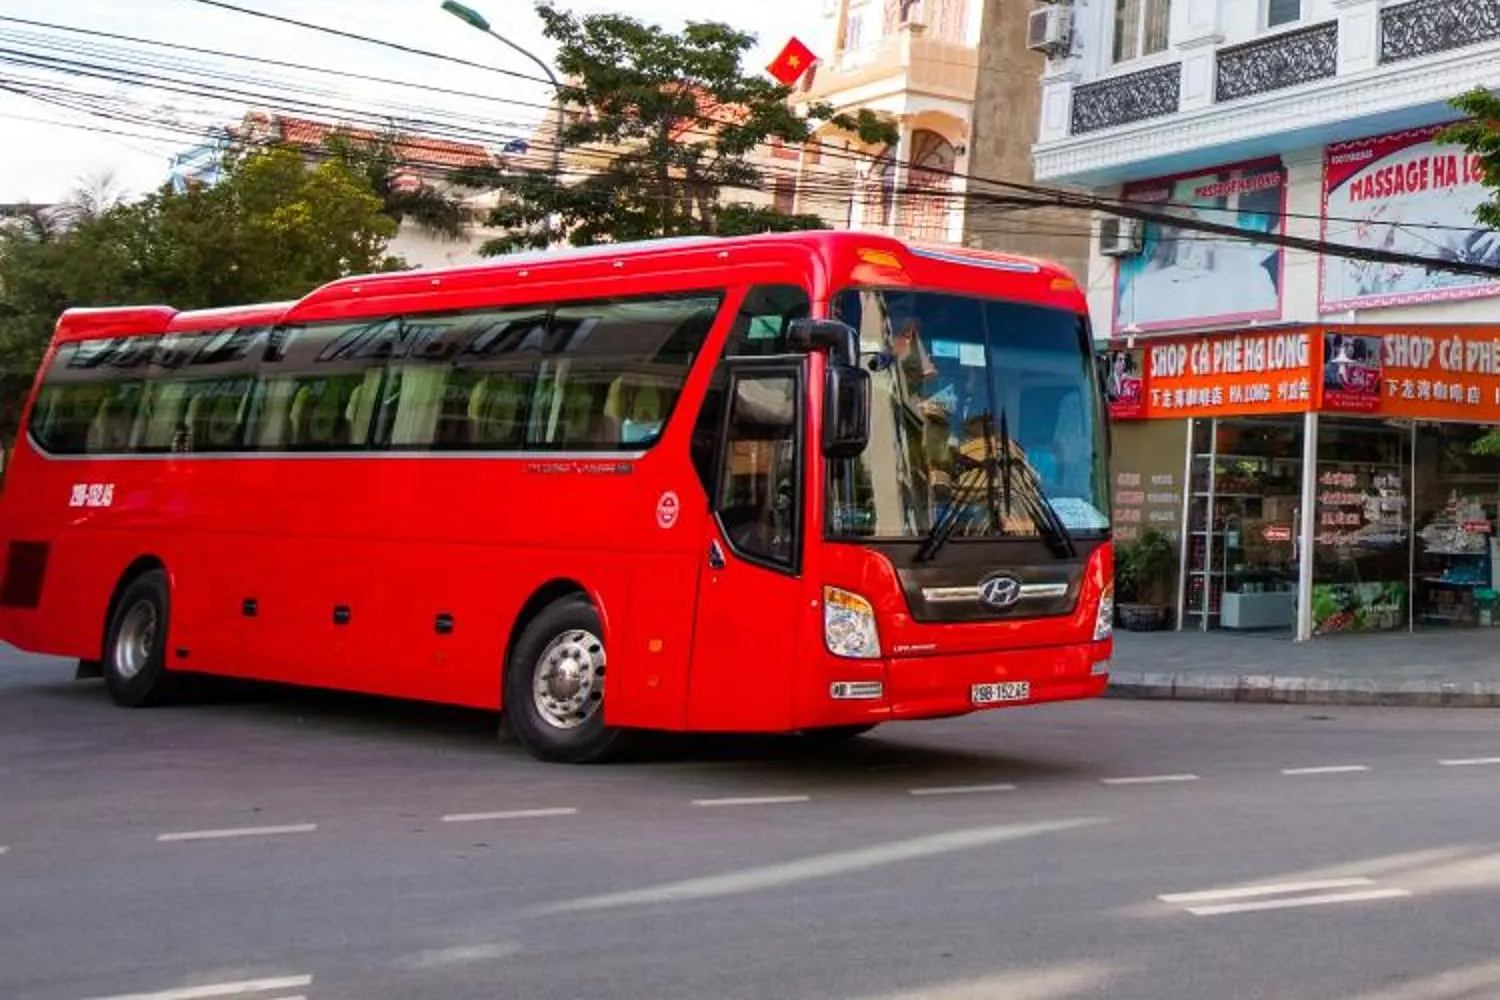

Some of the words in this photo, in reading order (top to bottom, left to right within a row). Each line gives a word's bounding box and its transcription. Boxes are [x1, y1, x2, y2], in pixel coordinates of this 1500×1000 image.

[1350, 157, 1429, 202] MASSAGE
[1151, 343, 1188, 378] SHOP
[1267, 333, 1310, 368] LONG
[1384, 334, 1434, 368] SHOP
